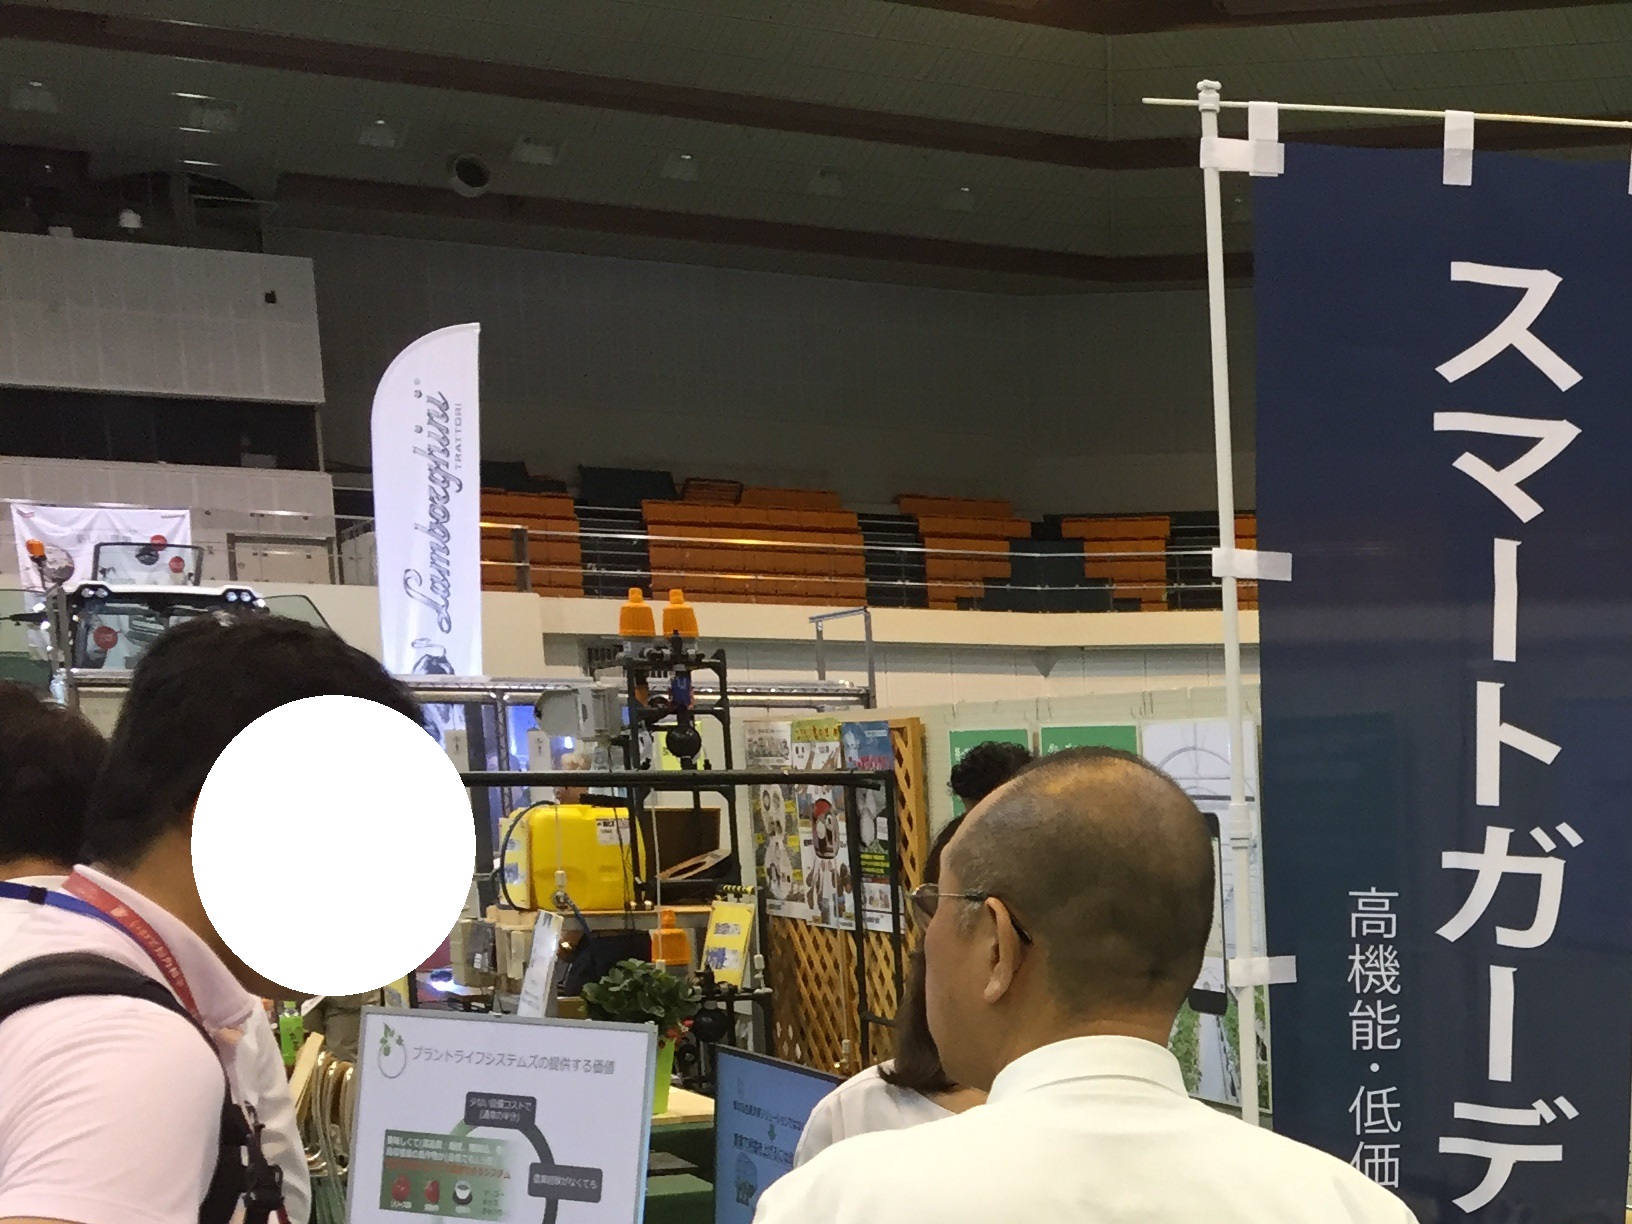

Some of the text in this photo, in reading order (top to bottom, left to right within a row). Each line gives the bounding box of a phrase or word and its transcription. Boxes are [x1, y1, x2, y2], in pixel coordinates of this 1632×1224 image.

[454, 403, 463, 470] TRATTORI
[403, 389, 463, 634] Lamborghini
[412, 1047, 616, 1075] プラントライフシステムズの提供する価値
